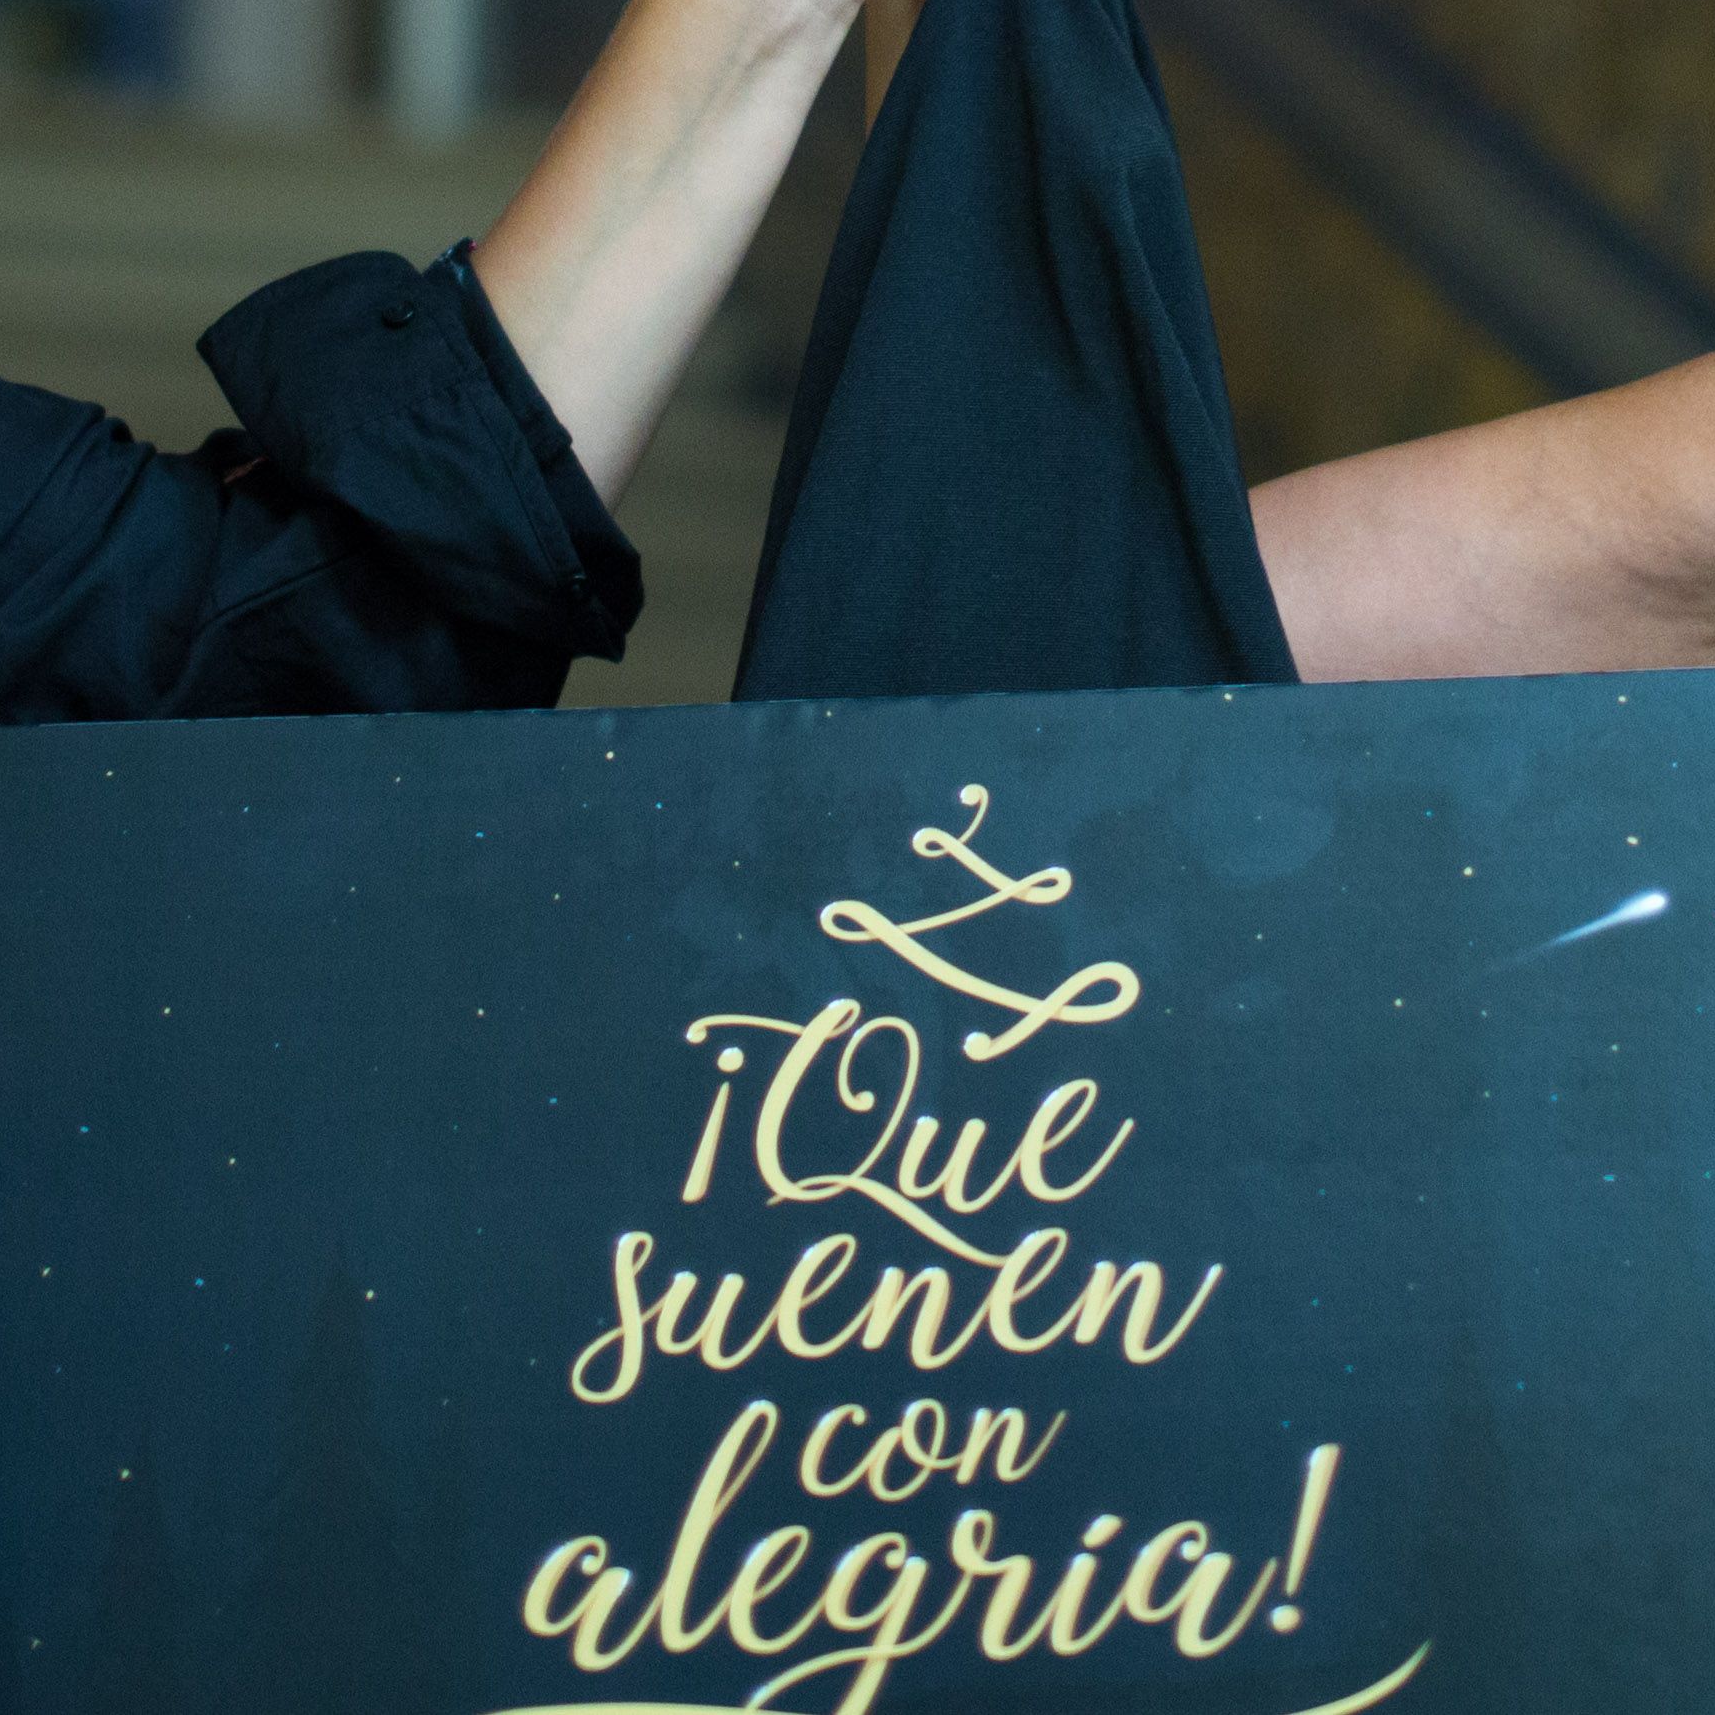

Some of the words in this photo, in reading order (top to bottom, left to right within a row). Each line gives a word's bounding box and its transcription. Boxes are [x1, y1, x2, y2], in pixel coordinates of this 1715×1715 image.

[682, 997, 1135, 1265] ¡Que
[571, 1228, 1224, 1404] suenen
[522, 1399, 1341, 1715] alegría!
[799, 1397, 1067, 1502] con
